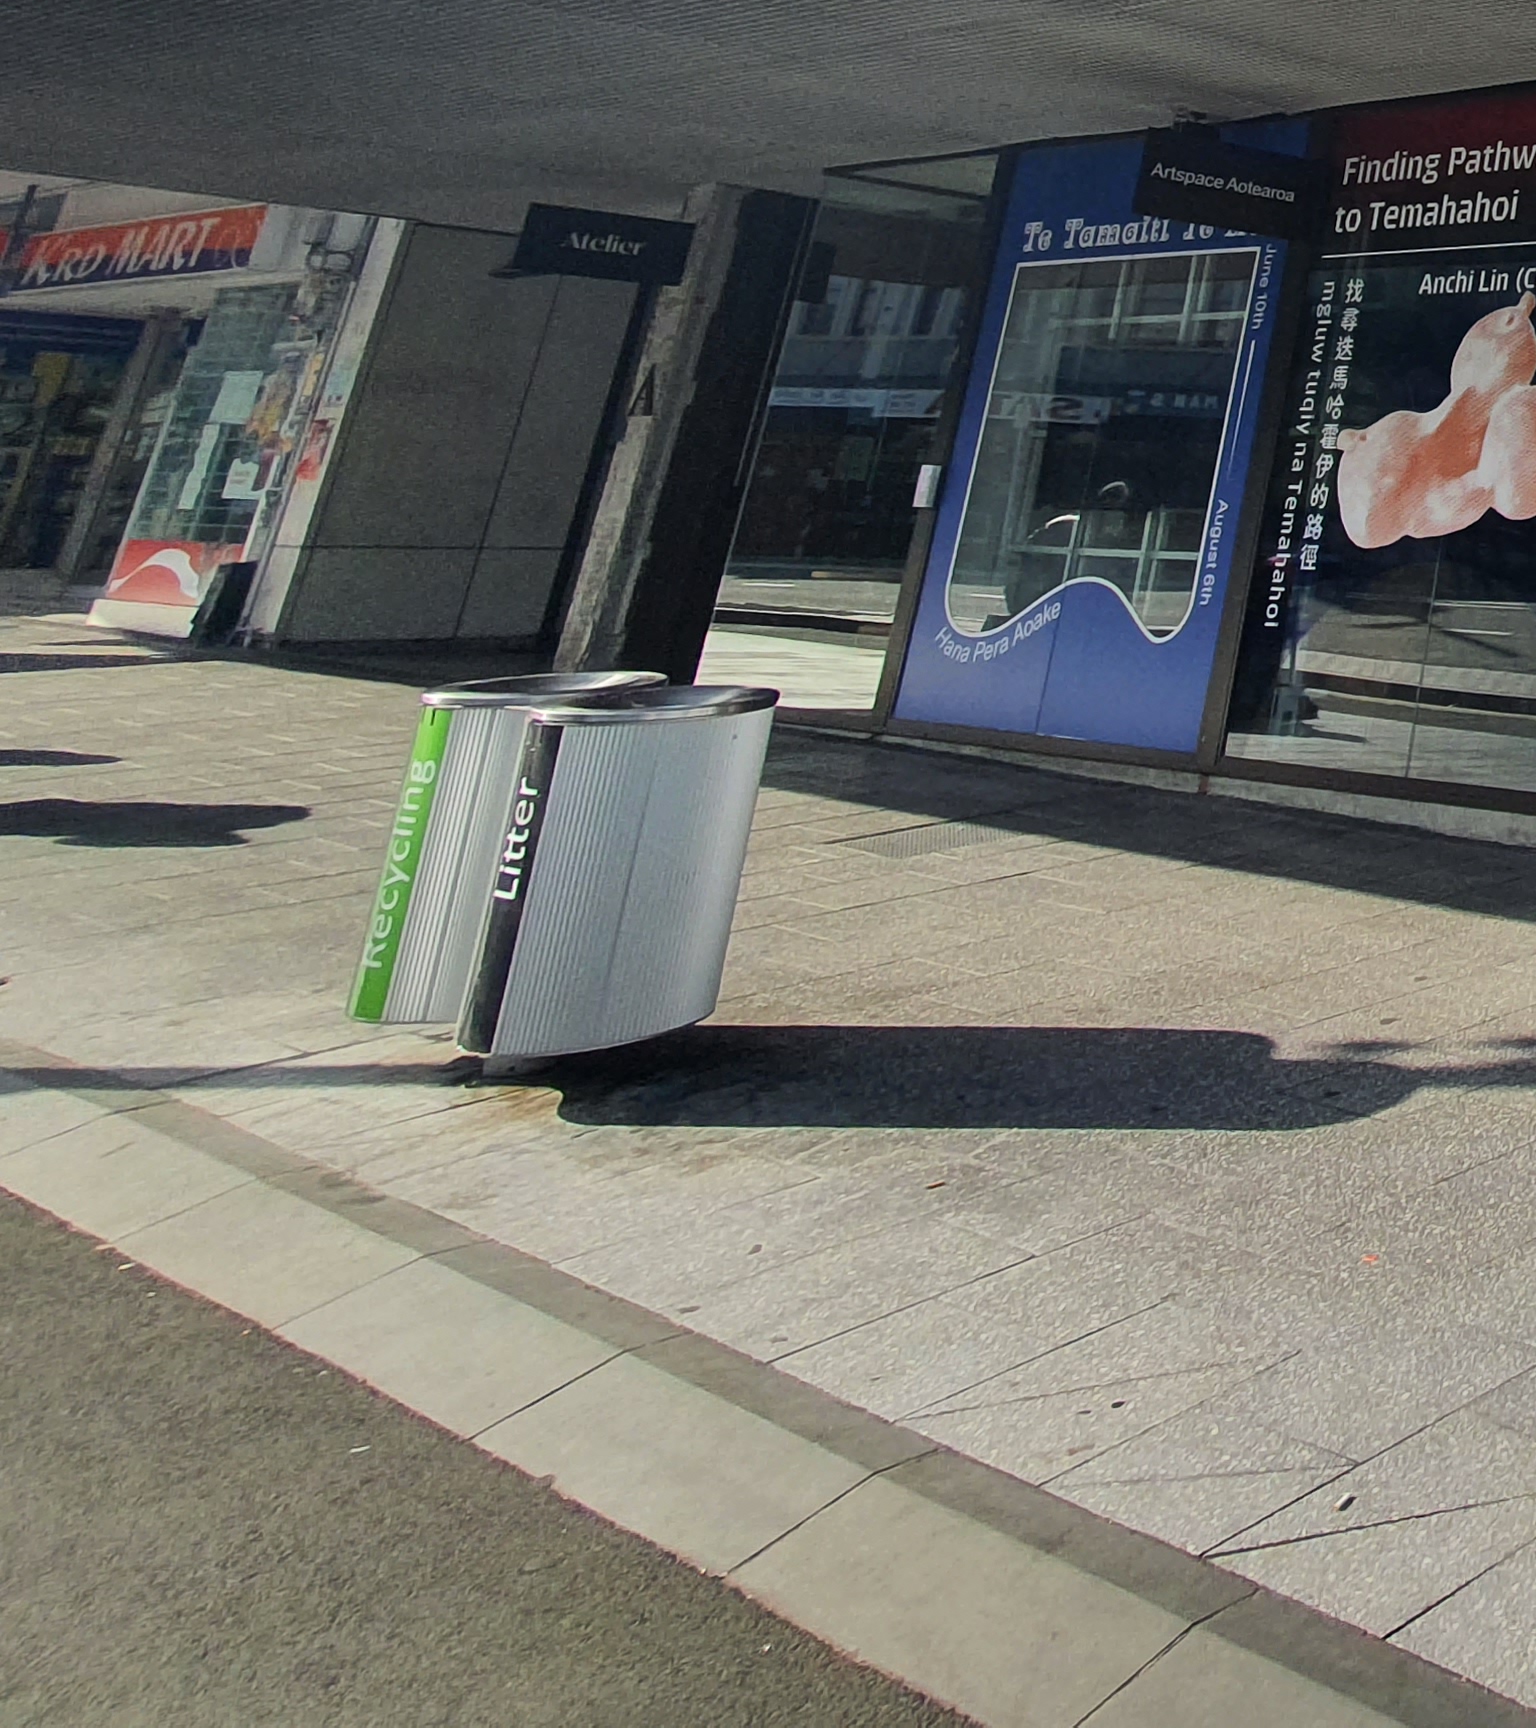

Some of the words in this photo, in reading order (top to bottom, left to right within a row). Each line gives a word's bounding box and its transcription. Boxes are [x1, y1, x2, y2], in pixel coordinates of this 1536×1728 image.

[1151, 162, 1224, 190] Artspace
[1225, 178, 1296, 203] Aotearoa
[1342, 150, 1442, 185] Finding
[1334, 206, 1362, 233] to
[1369, 189, 1521, 231] Temahahoi
[106, 217, 221, 276] MART
[561, 231, 647, 256] Atelier
[1023, 222, 1053, 252] Te
[1259, 244, 1277, 288] June
[1418, 269, 1474, 295] Anchi
[1478, 269, 1509, 292] Lin
[1252, 292, 1268, 330] 10th
[1290, 441, 1307, 472] na
[1204, 498, 1229, 571] August
[1264, 479, 1304, 627] Temahahoi
[1199, 574, 1215, 606] 6th
[935, 626, 968, 663] Hana
[973, 637, 1009, 663] Pera
[1012, 601, 1062, 647] Aoake
[493, 777, 541, 900] Litter
[363, 758, 435, 969] Recycling
